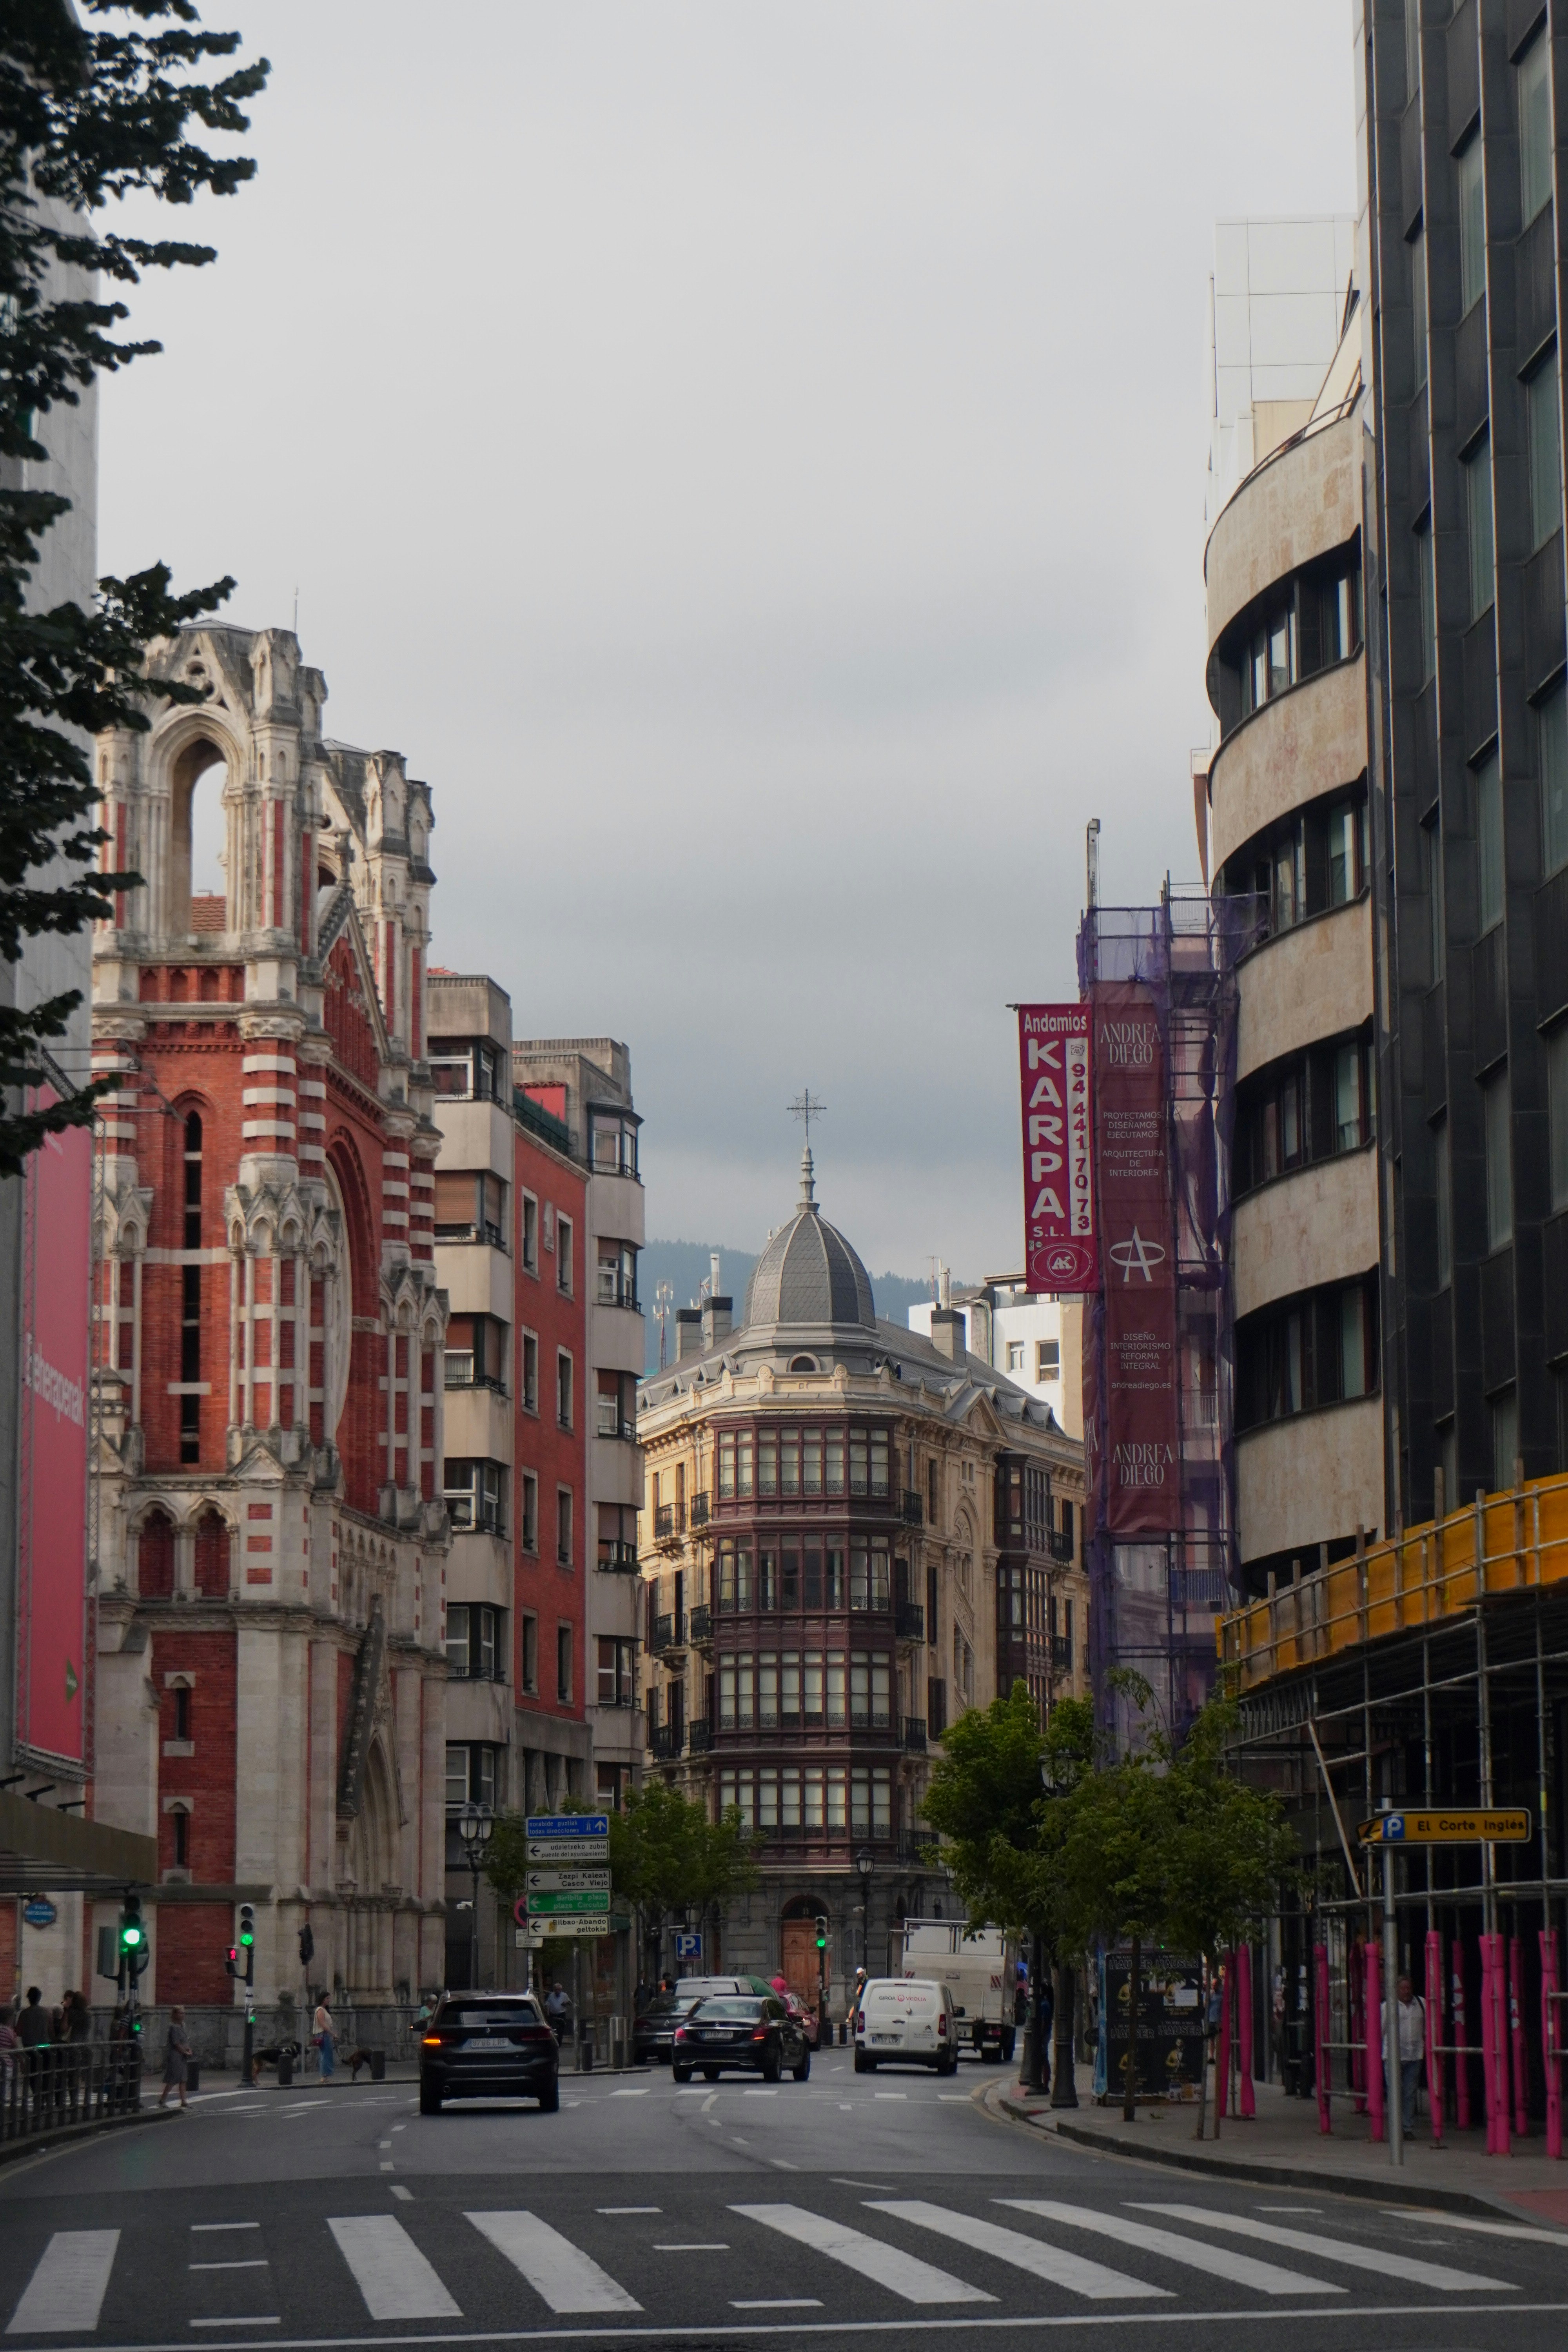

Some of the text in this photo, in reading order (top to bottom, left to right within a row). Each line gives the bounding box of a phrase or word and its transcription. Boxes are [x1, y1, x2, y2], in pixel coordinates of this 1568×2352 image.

[1024, 1011, 1087, 1033] Andamios
[1100, 1023, 1161, 1045] ANDREA
[1109, 1044, 1153, 1064] DIEGO
[1028, 1038, 1065, 1219] KARPA
[1109, 1120, 1158, 1129] DISEÑAMOS
[1102, 1150, 1164, 1159] ARQUITECTURA
[1033, 1226, 1064, 1237] S.L.
[1123, 1332, 1155, 1341] DISEÑO
[1112, 1381, 1171, 1390] andreadiego.es
[1113, 1444, 1173, 1465] ANDREA
[1120, 1465, 1164, 1485] DIEGO
[1388, 1818, 1525, 1837] P El Corte Inglés
[681, 1936, 695, 1956] P
[1109, 1959, 1153, 1970] HAUER
